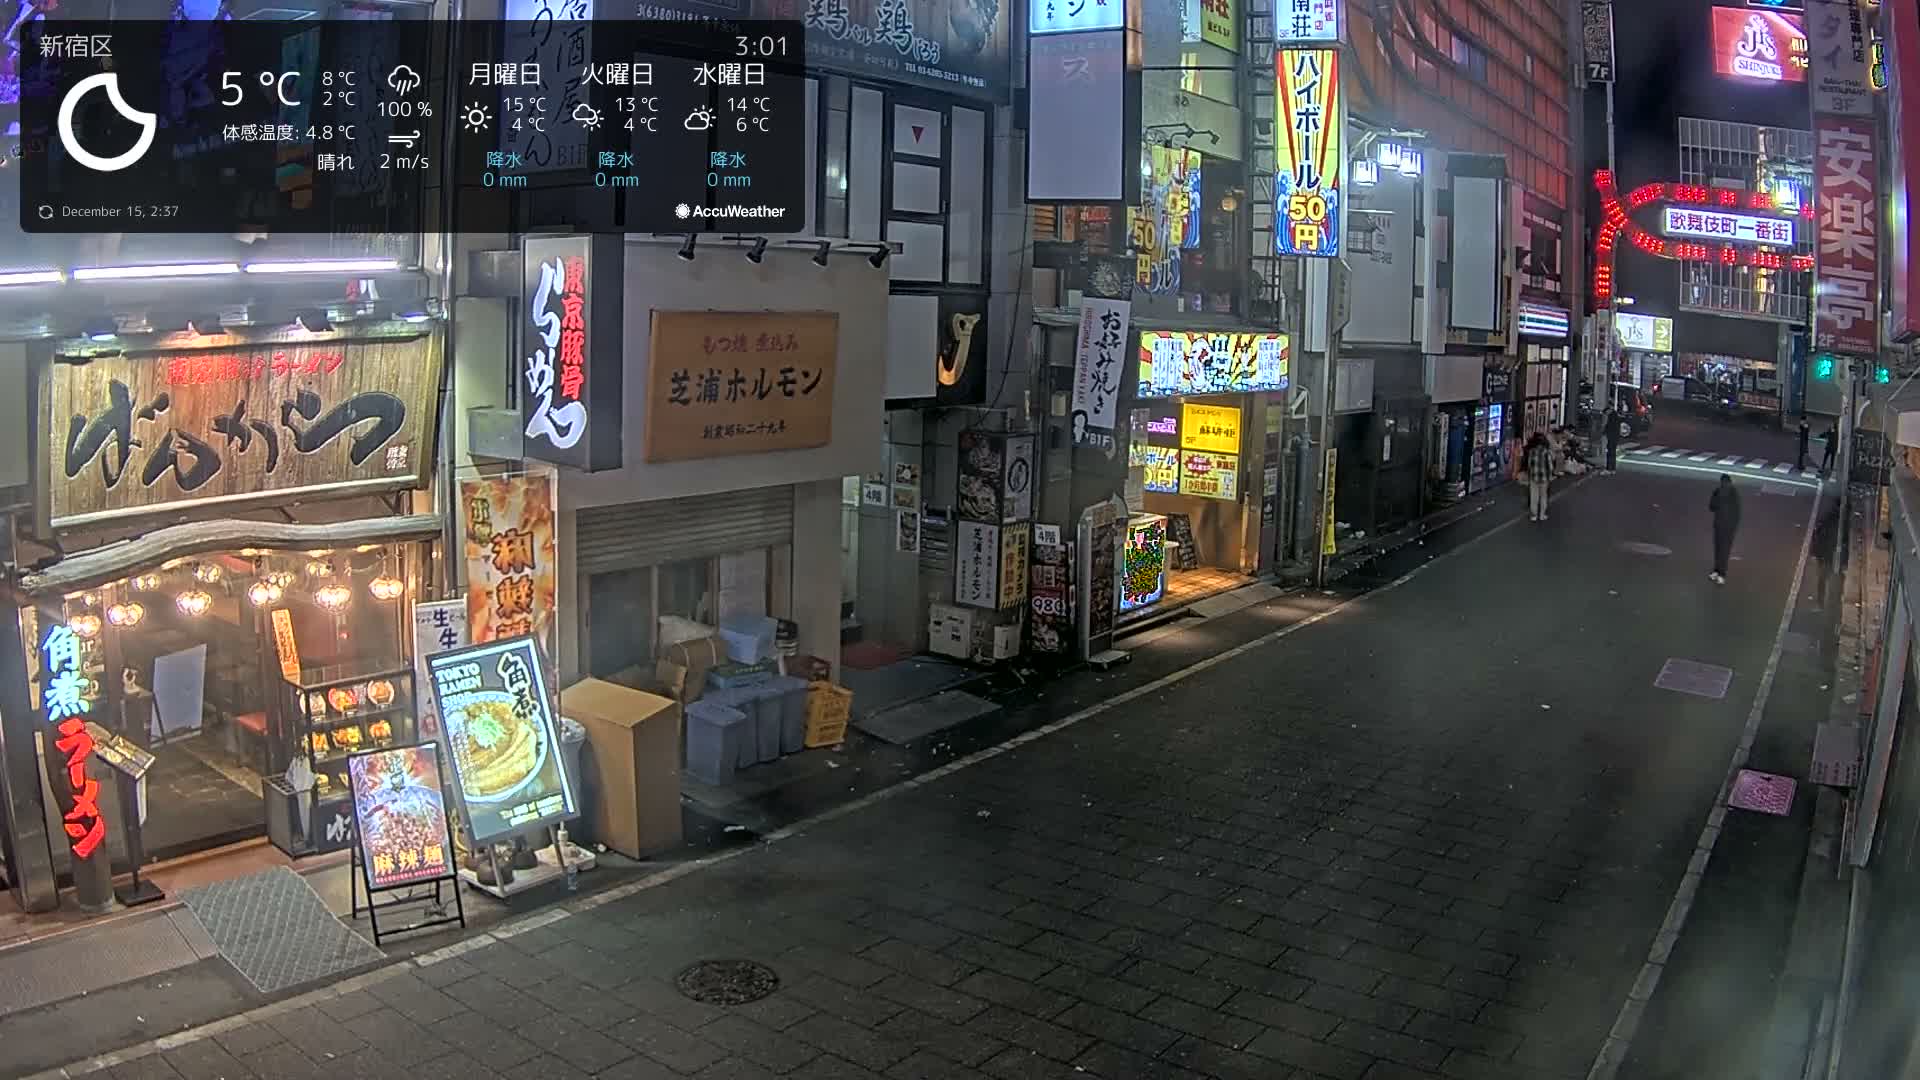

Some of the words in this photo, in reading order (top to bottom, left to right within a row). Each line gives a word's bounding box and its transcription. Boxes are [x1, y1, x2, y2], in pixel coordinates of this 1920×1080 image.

[1295, 54, 1321, 189] ハイボール
[1669, 210, 1790, 242] 歌舞伎町一番街
[1820, 127, 1875, 329] 安楽亭
[559, 255, 586, 401] 東京豚骨
[668, 366, 823, 406] 芝浦ホルモン
[972, 528, 983, 601] 芝浦ホルモン
[43, 625, 90, 721] 角煮
[435, 663, 481, 681] TOKYO
[439, 675, 482, 696] RAMEN
[501, 657, 539, 720] 角煮
[55, 718, 105, 858] ラーメン
